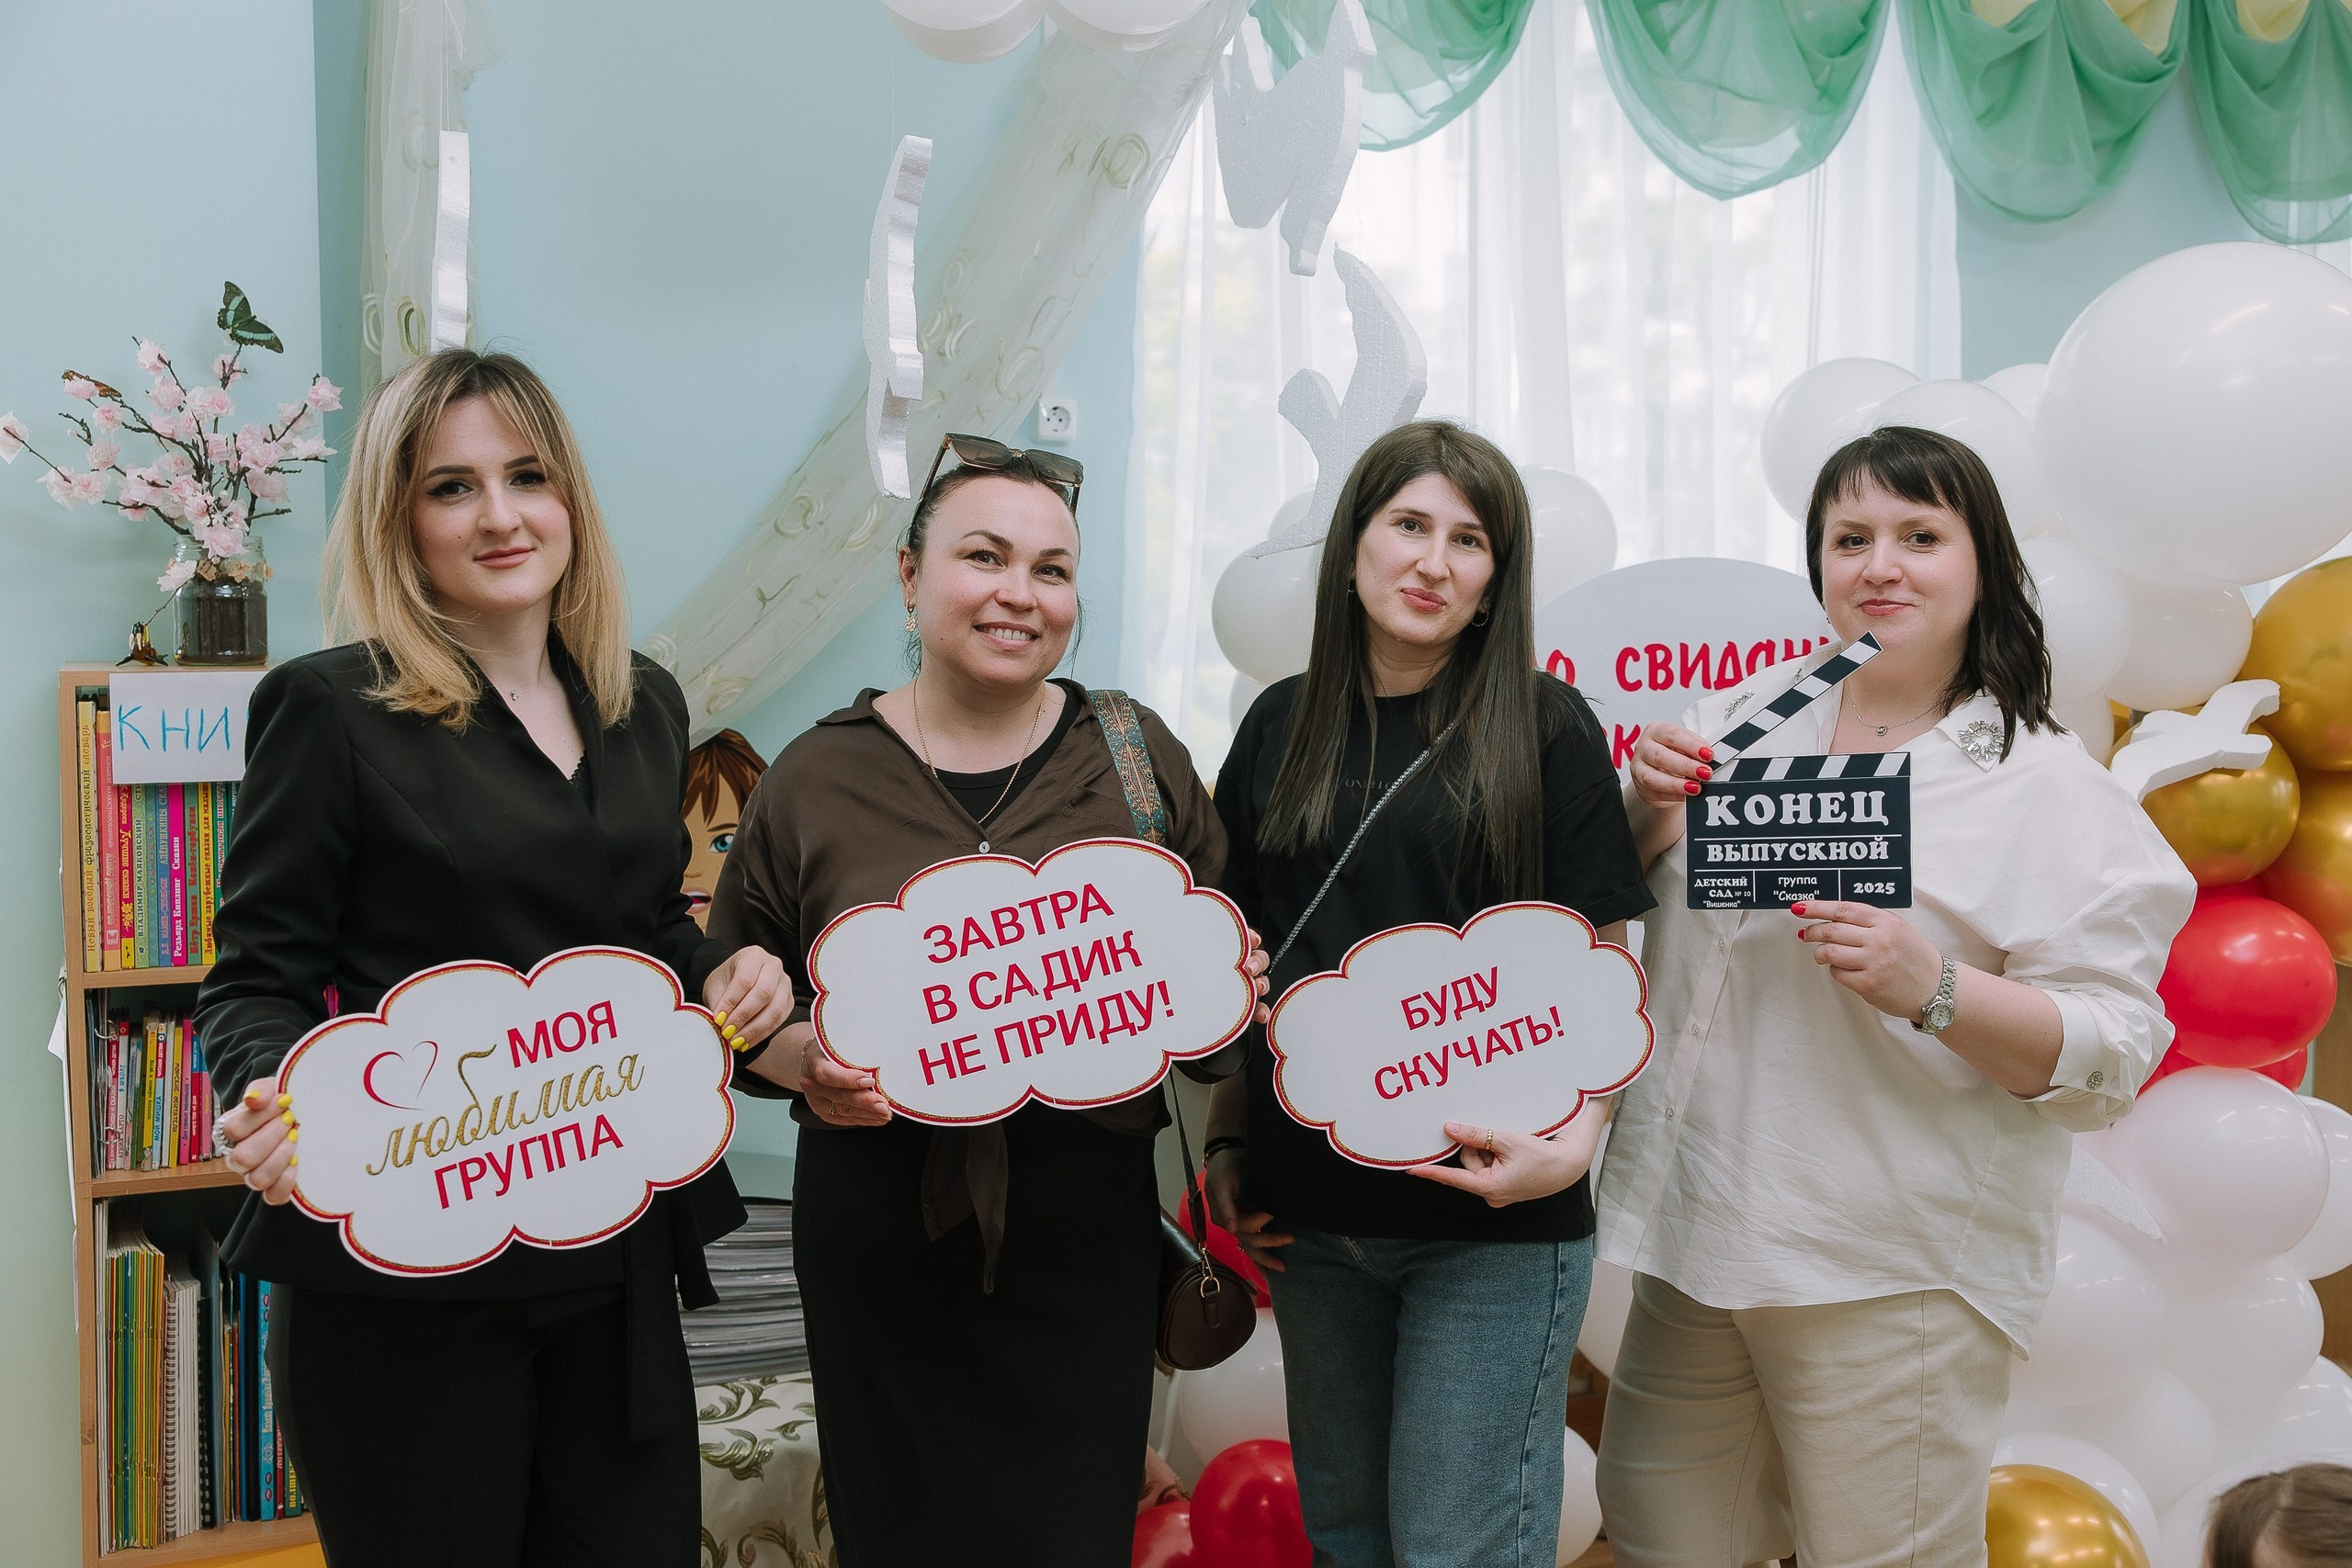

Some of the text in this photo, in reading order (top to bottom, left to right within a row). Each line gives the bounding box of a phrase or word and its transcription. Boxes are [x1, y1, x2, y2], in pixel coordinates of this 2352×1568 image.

[1616, 636, 1830, 692] СВИДАН
[118, 704, 250, 753] КНИ
[1705, 790, 1890, 827] КОНЕЦ
[82, 725, 96, 952] Новый весёлый фразеологический словарь
[119, 829, 130, 867] Лучшие
[159, 808, 168, 864] АЛЁНУШКИНЫ
[1706, 835, 1890, 863] ВЫПУСКНОЙ
[121, 869, 130, 899] сказки
[172, 837, 183, 957] Редьярд Киплинг Сказки
[203, 863, 213, 914] зарубежные
[1694, 875, 1747, 887] ДЕТСКИЙ
[1702, 900, 1741, 908] "Вишенка"
[1709, 889, 1734, 898] САД
[1773, 890, 1820, 902] "Сказка"
[1778, 876, 1818, 888] группа
[1853, 882, 1895, 895] 2025
[204, 916, 213, 954] Любимые
[922, 883, 1115, 965] ЗАВТРА
[922, 930, 1144, 1026] В САДИК
[1399, 965, 1499, 1032] БУДУ
[506, 999, 619, 1069] МОЯ
[917, 979, 1176, 1087] НЕ ПРИДУ!
[1374, 1005, 1566, 1100] СКУЧАТЬ!
[365, 1043, 645, 1177] любимая
[434, 1113, 624, 1210] ГРУППА
